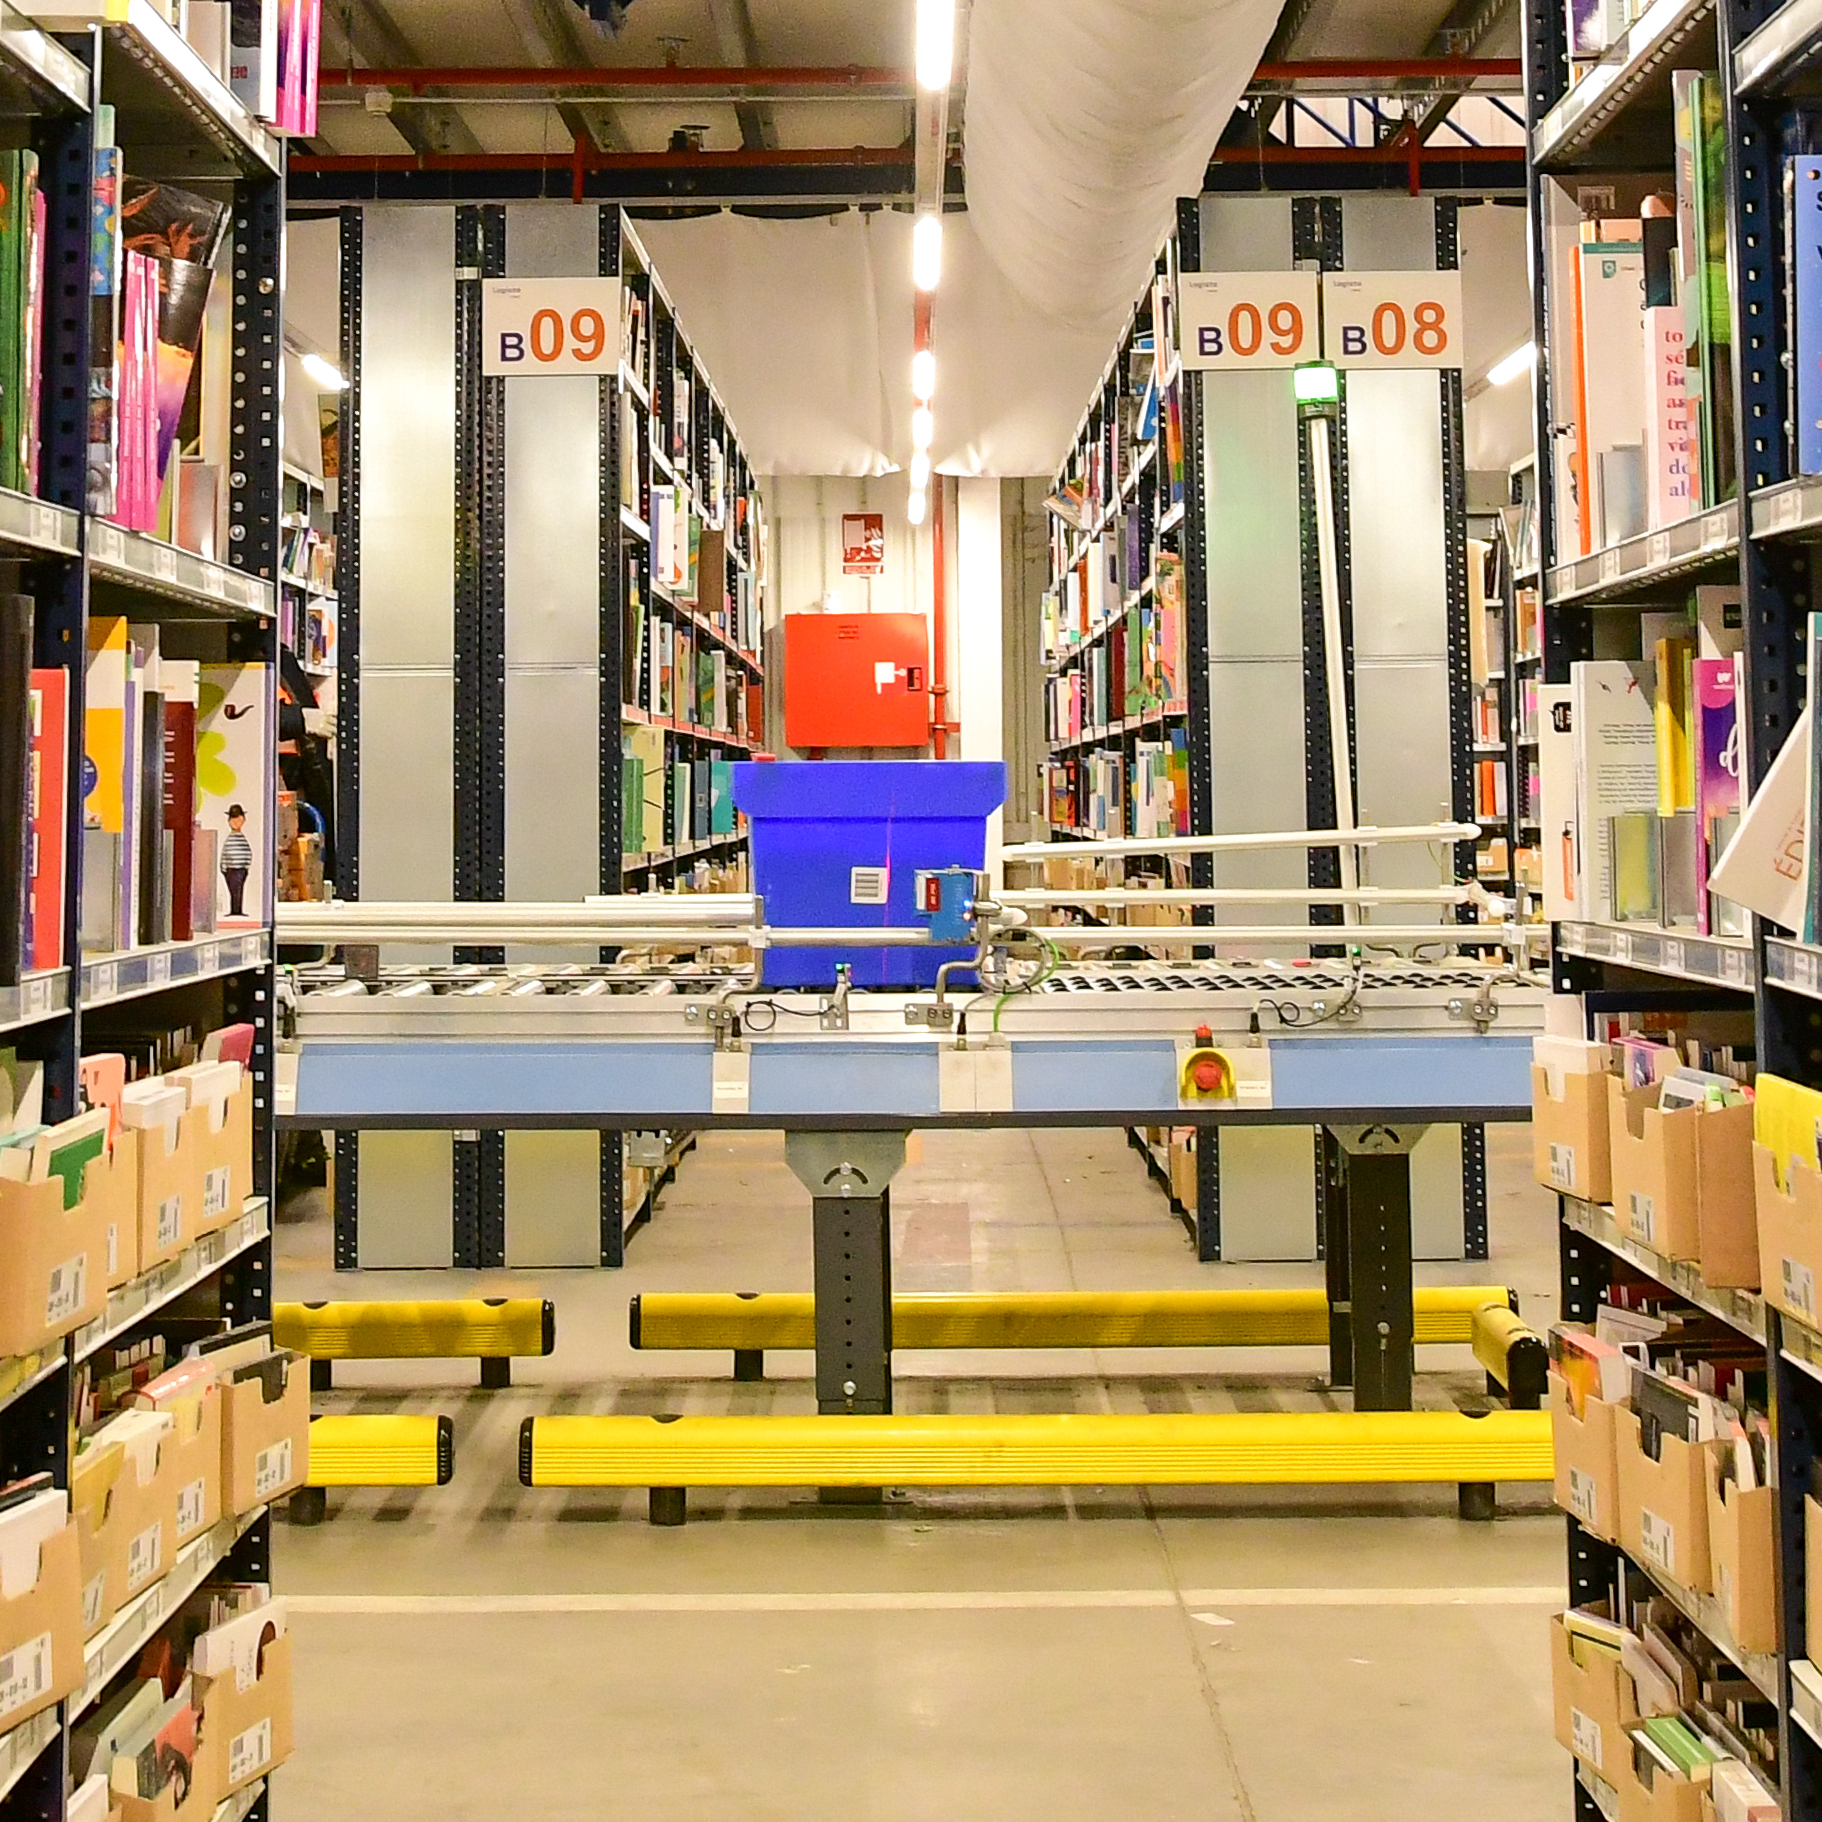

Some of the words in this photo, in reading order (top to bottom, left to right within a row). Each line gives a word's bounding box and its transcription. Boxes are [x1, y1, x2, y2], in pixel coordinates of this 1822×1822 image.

[500, 308, 606, 363] B09
[1198, 302, 1304, 357] B09
[1342, 301, 1448, 356] B08
